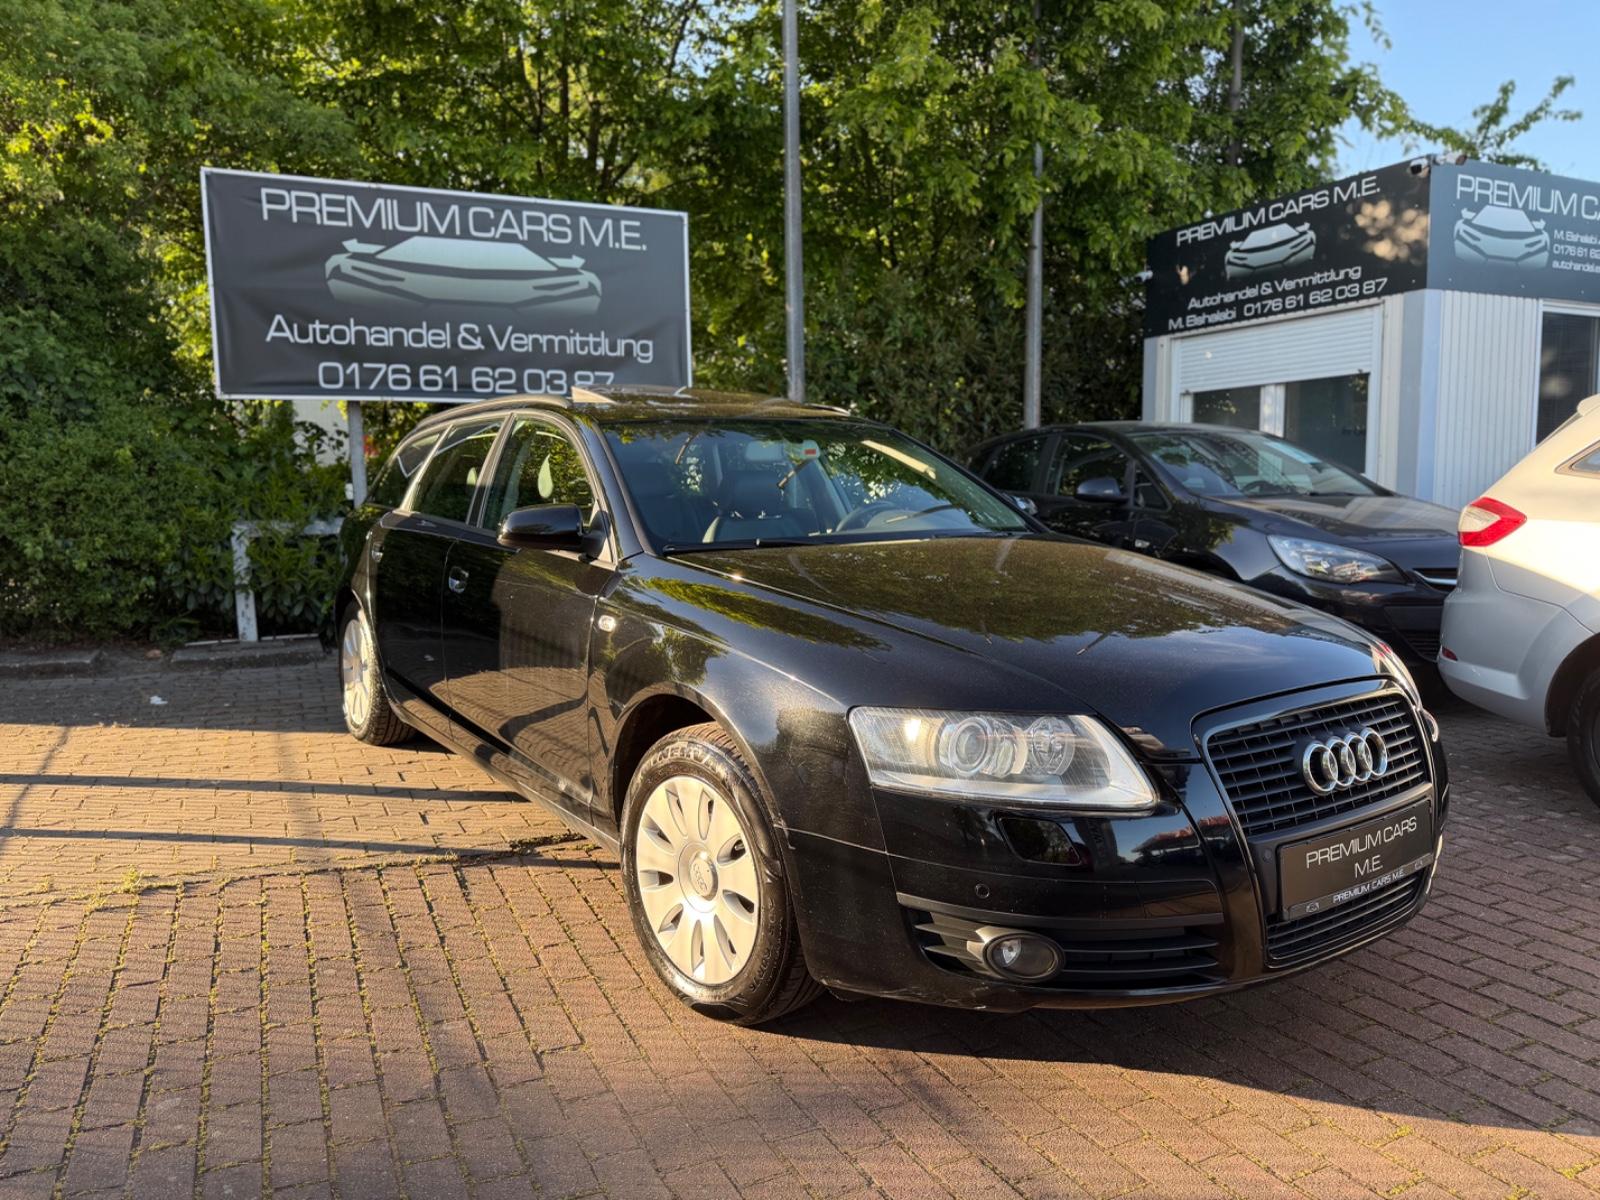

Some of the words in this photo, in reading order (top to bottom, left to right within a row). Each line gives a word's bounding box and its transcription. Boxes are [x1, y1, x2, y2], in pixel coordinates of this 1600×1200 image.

[260, 187, 461, 236] PREMIUM
[468, 207, 571, 244] CARS
[579, 216, 647, 251] M.E.
[1176, 207, 1266, 247] PREMIUM
[1269, 189, 1329, 221] CARS
[1333, 175, 1381, 203] M.E.
[1456, 174, 1578, 217] PREMIUM
[1581, 195, 1600, 221] C
[1168, 316, 1185, 331] M.
[1243, 298, 1283, 317] 0176
[1285, 294, 1304, 310] 61
[1309, 288, 1332, 306] 62
[1335, 283, 1360, 300] 03
[1362, 277, 1388, 296] 87
[1187, 283, 1259, 311] Autohandel
[1260, 281, 1273, 296] &
[1274, 265, 1361, 292] Vermittlung
[265, 314, 450, 349] Autohandel
[457, 323, 485, 350] &
[488, 324, 653, 364] Vermittlung
[318, 361, 410, 390] 0176
[419, 364, 458, 391] 61
[471, 366, 516, 393] 62
[524, 368, 567, 395] 03
[1306, 830, 1382, 869] PREMIUM
[1383, 816, 1417, 844] CARS
[1332, 883, 1370, 904] PREMIUM
[1371, 876, 1391, 890] CARS
